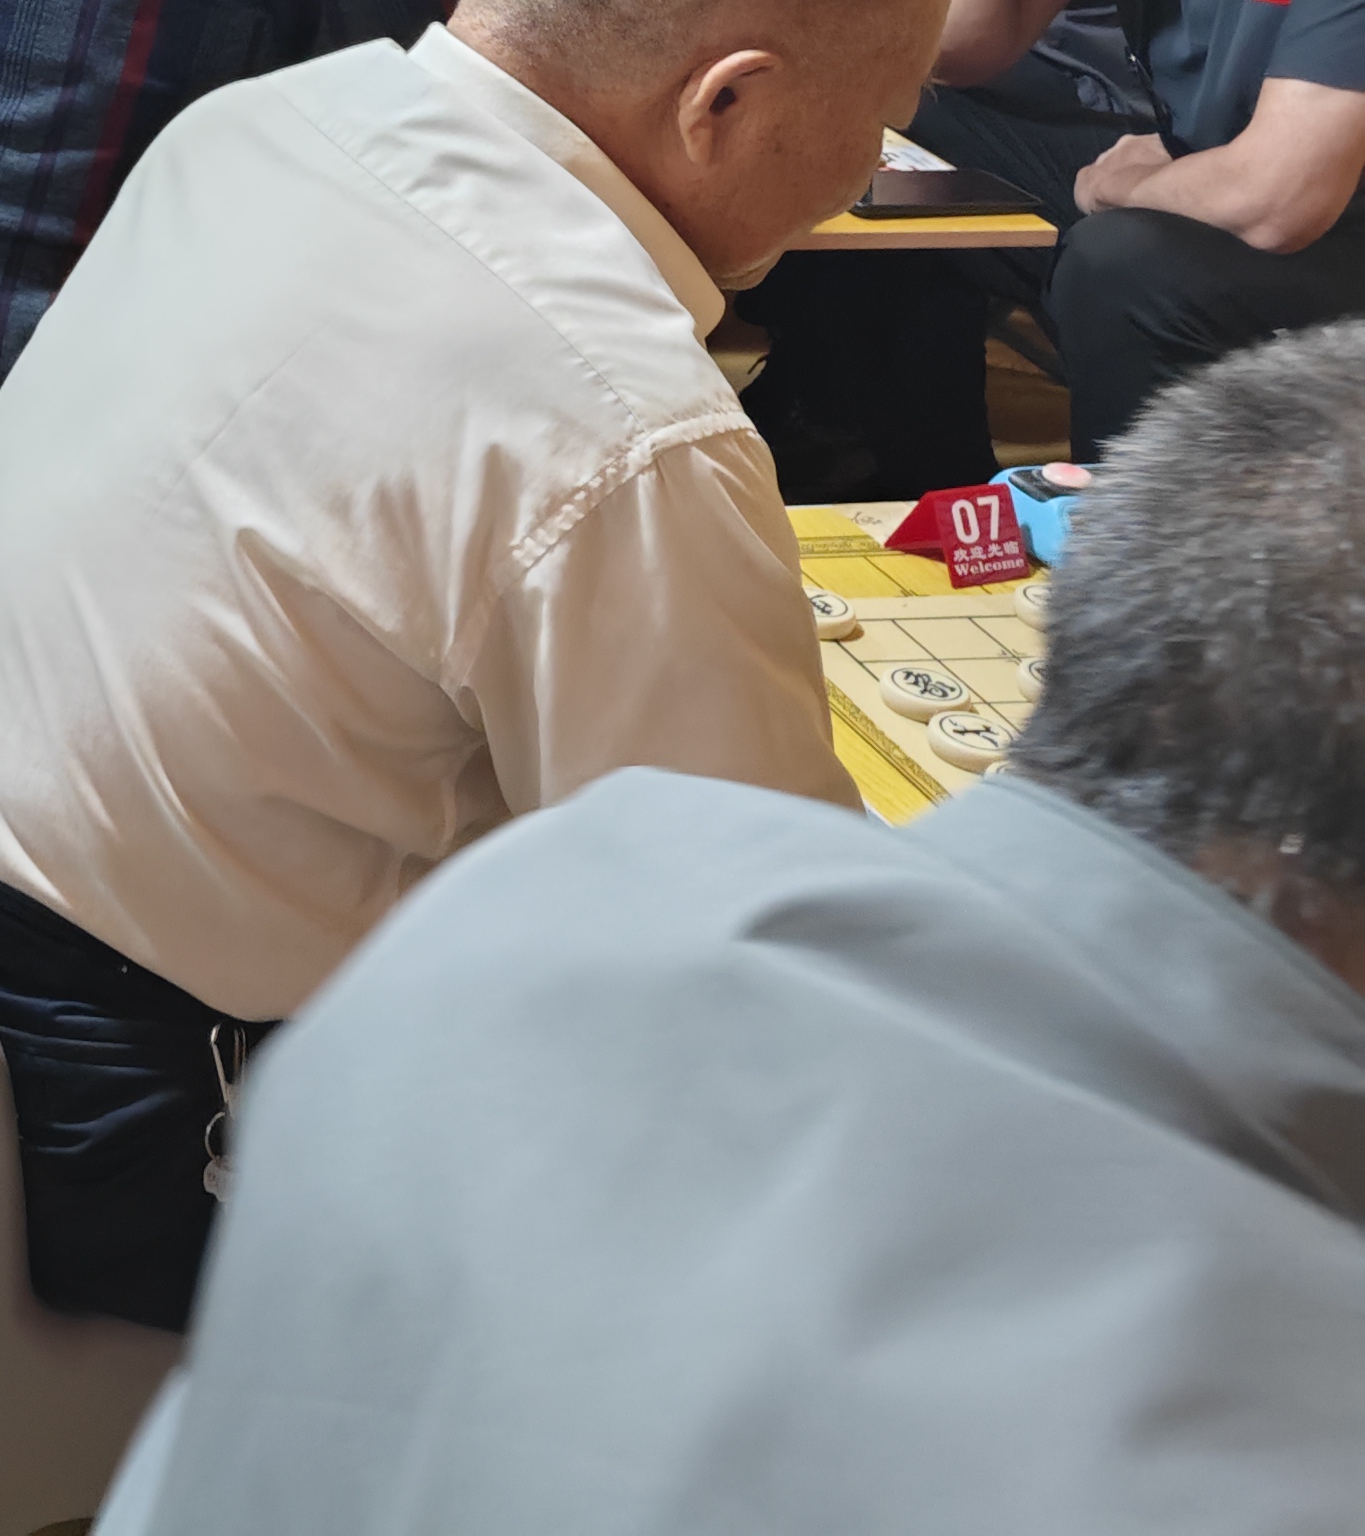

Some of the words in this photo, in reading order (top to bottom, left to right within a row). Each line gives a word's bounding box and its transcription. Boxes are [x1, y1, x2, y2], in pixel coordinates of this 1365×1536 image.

[951, 495, 1000, 544] 07
[953, 540, 1019, 563] 欢迎光临
[954, 558, 1025, 576] Welcome
